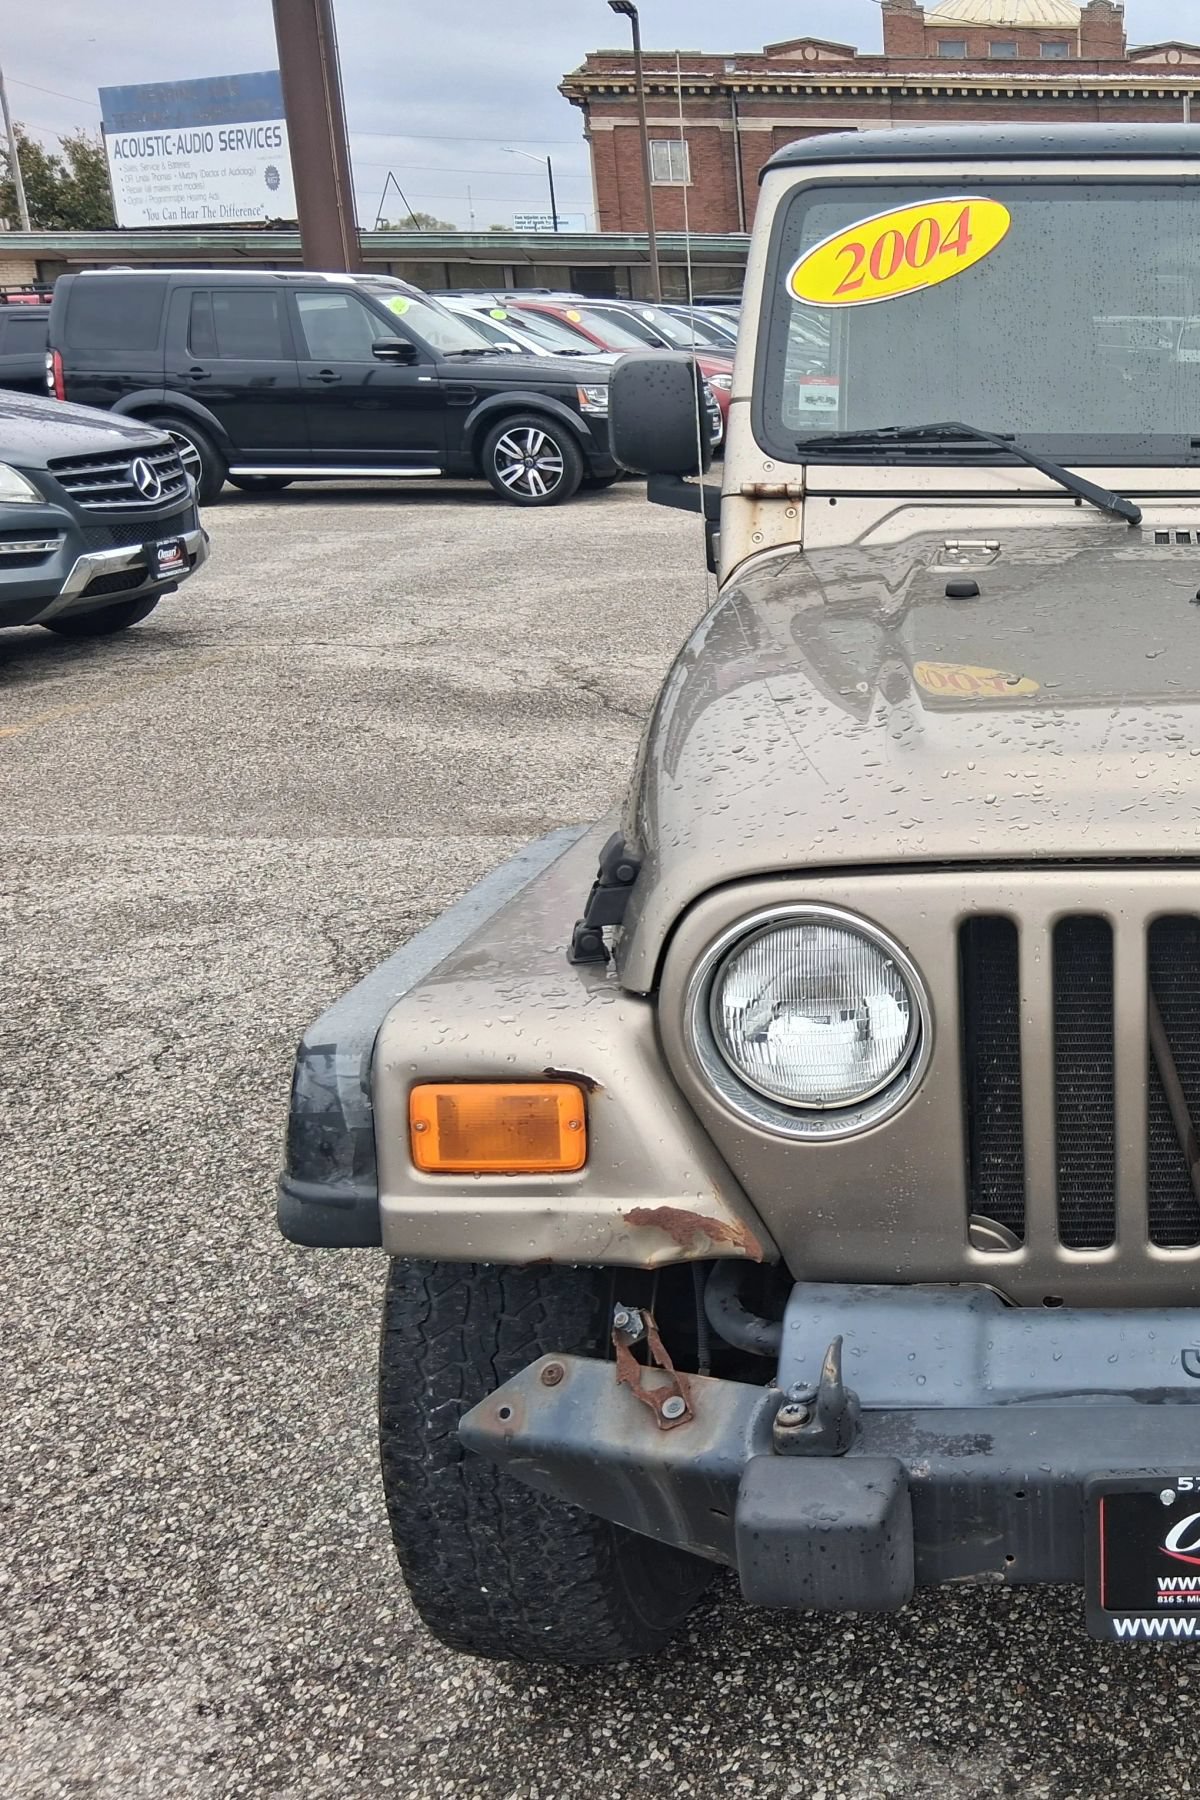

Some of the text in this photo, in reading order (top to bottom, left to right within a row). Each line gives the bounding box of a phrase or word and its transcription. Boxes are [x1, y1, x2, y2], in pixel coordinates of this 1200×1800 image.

[218, 126, 282, 152] SERVICES
[162, 207, 178, 221] Can
[180, 206, 199, 220] Hear
[200, 205, 217, 219] The
[832, 205, 973, 297] 2004
[1157, 1594, 1174, 1603] 816
[1176, 1595, 1185, 1604] S.
